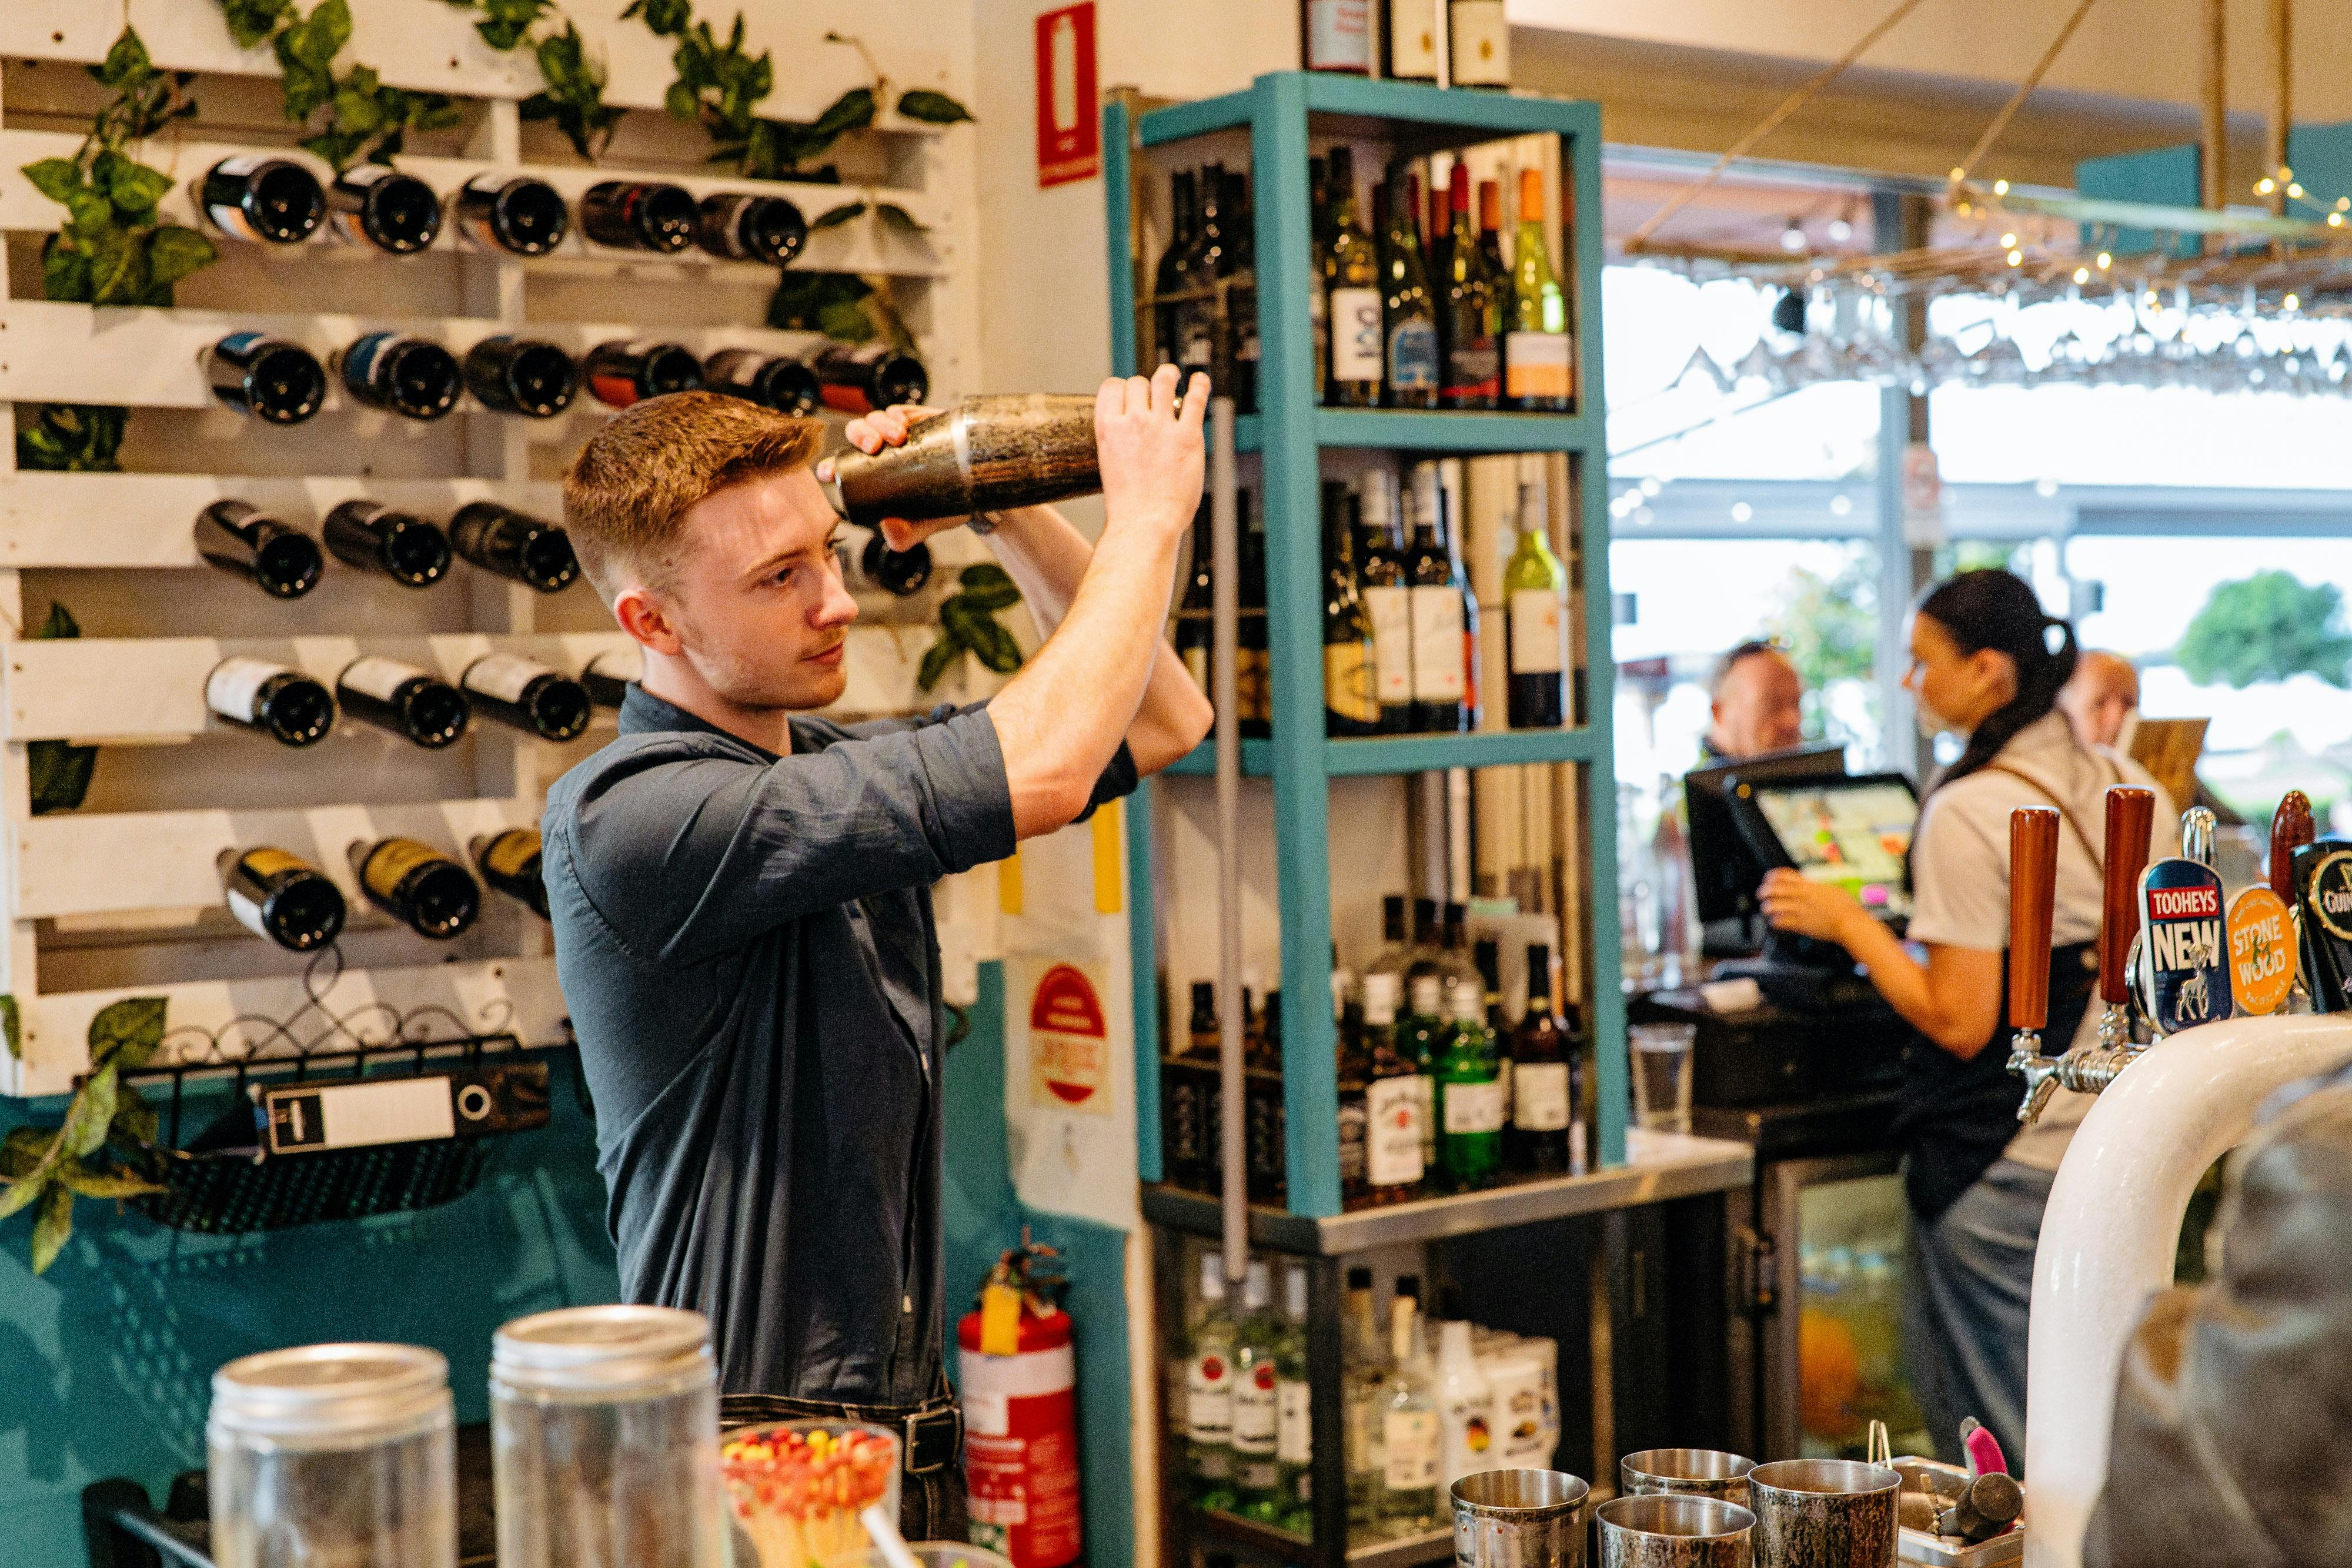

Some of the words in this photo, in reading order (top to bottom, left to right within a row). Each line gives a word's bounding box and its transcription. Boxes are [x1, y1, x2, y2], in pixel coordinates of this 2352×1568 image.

[2153, 890, 2217, 915] TOOHEYS
[2152, 920, 2221, 972] NEW
[2233, 914, 2283, 957] STONE
[2238, 947, 2286, 987] WOOD
